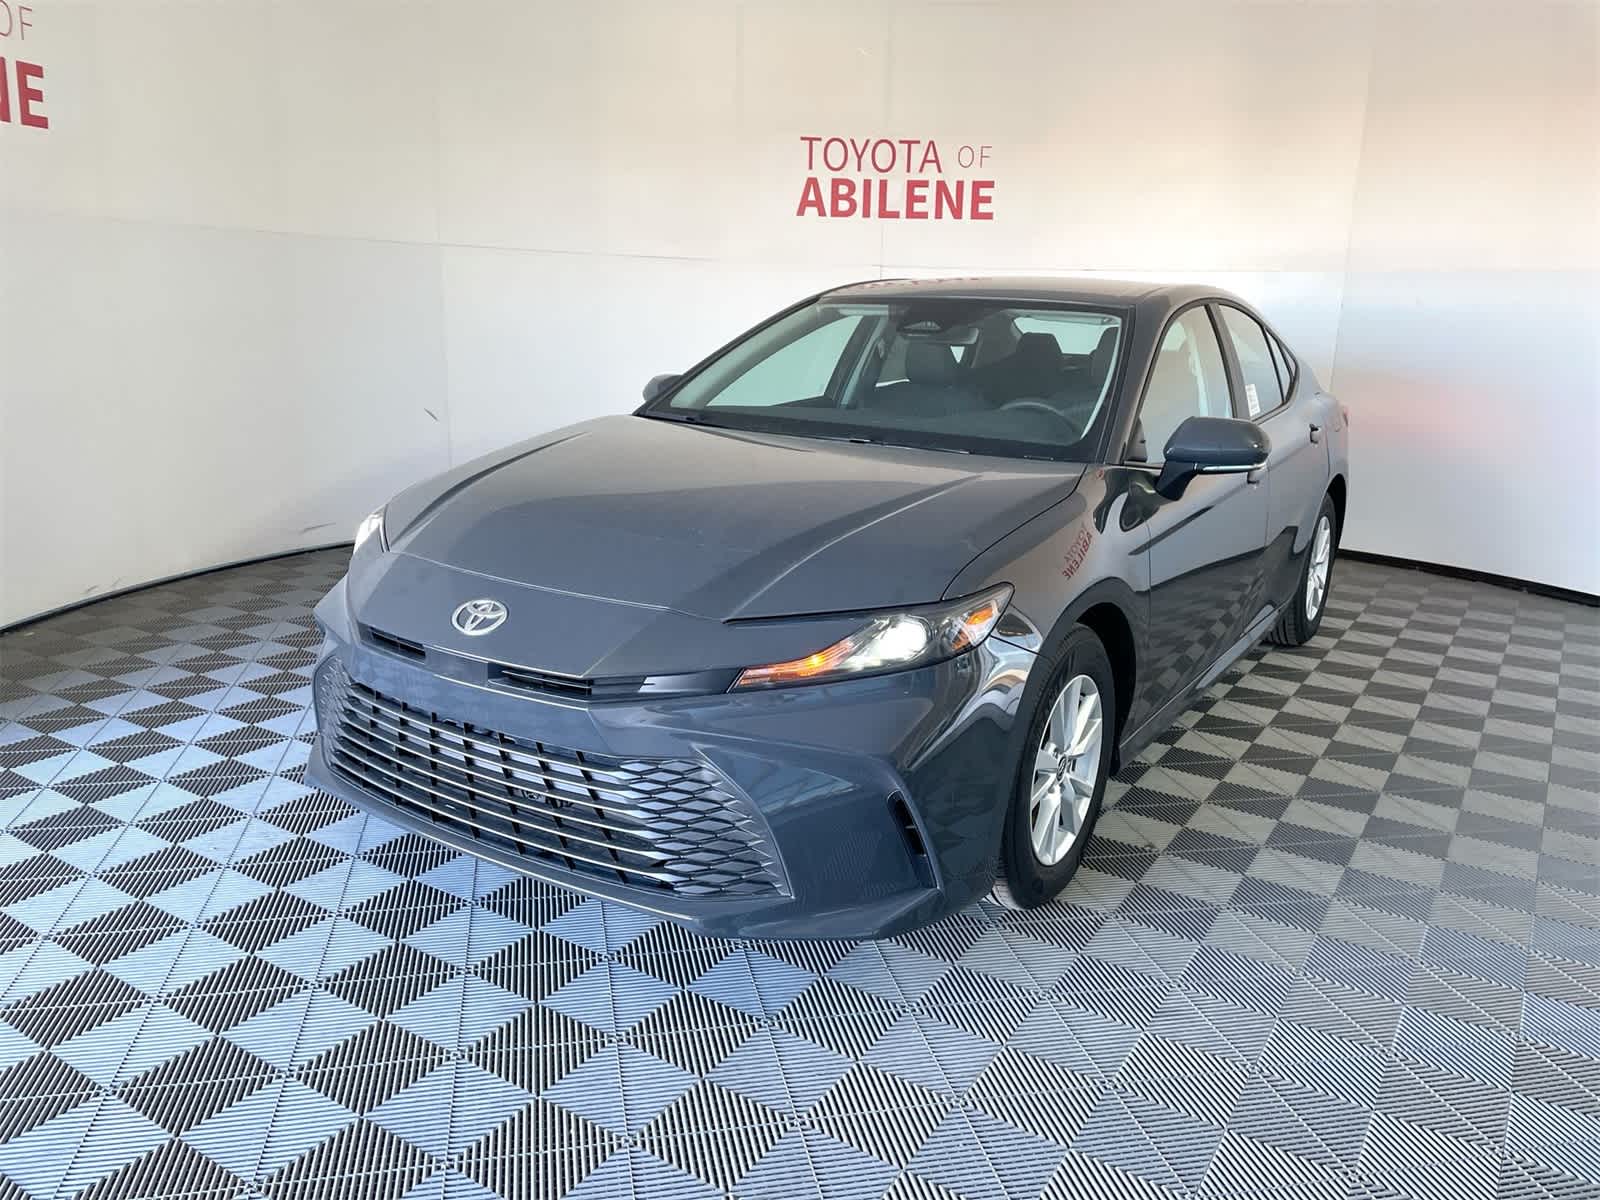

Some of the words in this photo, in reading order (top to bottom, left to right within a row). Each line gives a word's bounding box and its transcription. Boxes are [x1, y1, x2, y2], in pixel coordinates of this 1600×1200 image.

[0, 56, 49, 129] E
[800, 136, 942, 173] TOYOTA
[958, 145, 992, 168] OF
[796, 177, 995, 220] ABILENE
